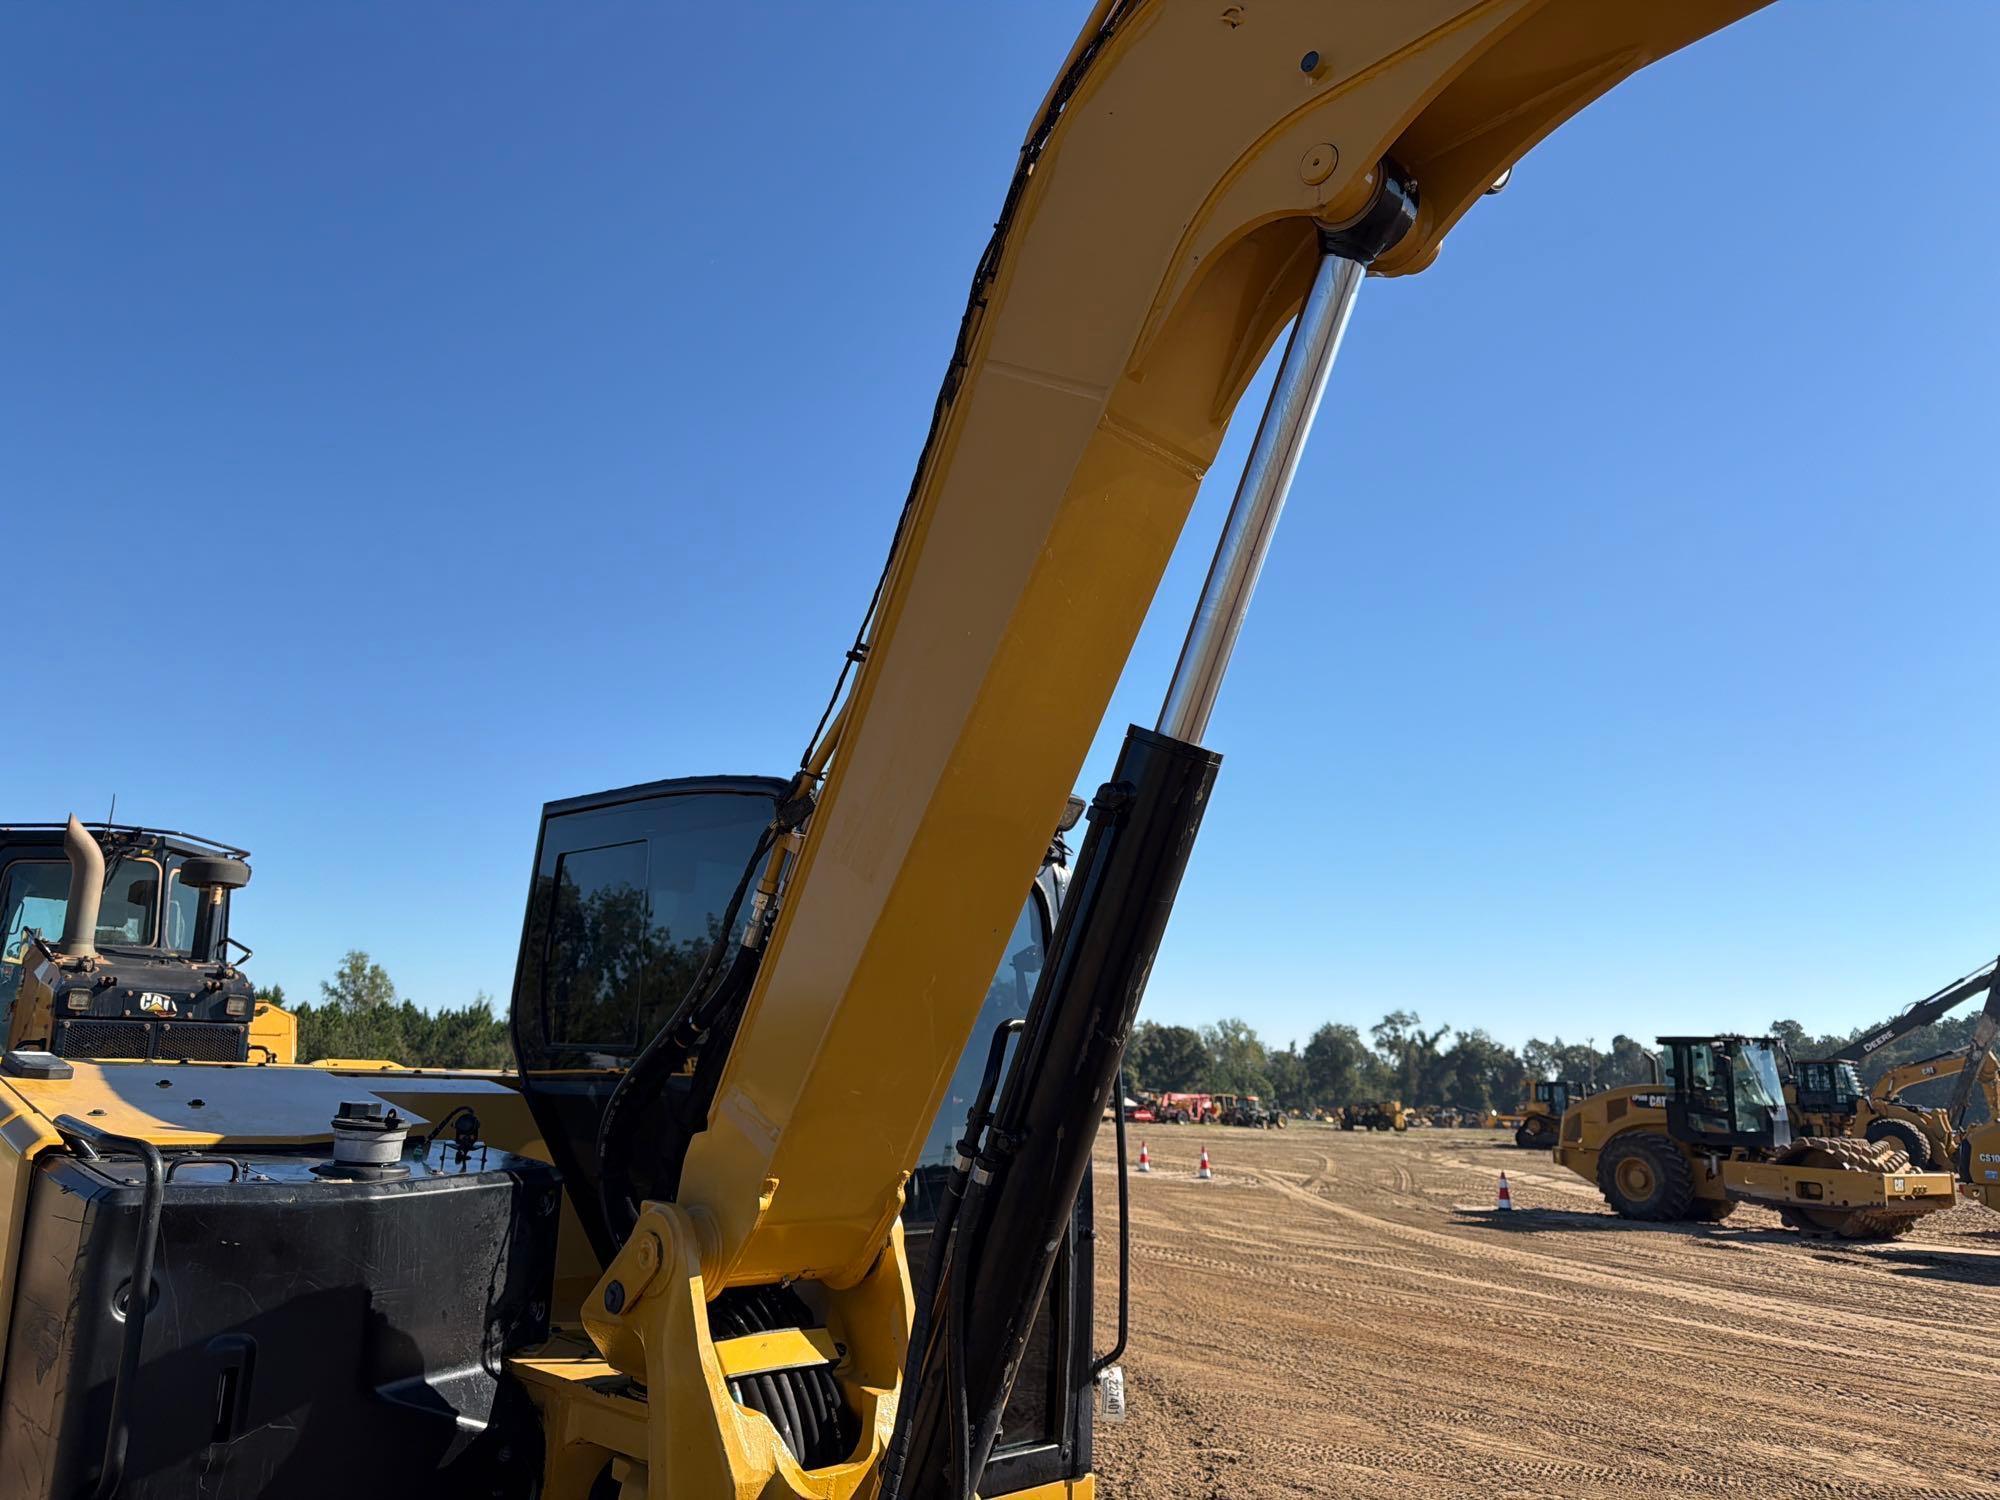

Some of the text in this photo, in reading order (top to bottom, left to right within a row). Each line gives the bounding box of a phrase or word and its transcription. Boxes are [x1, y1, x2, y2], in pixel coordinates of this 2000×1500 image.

[140, 992, 171, 1012] CAT
[1863, 1030, 1896, 1052] DEERE
[1649, 1095, 1666, 1107] CAT
[1108, 1379, 1120, 1414] 227401
